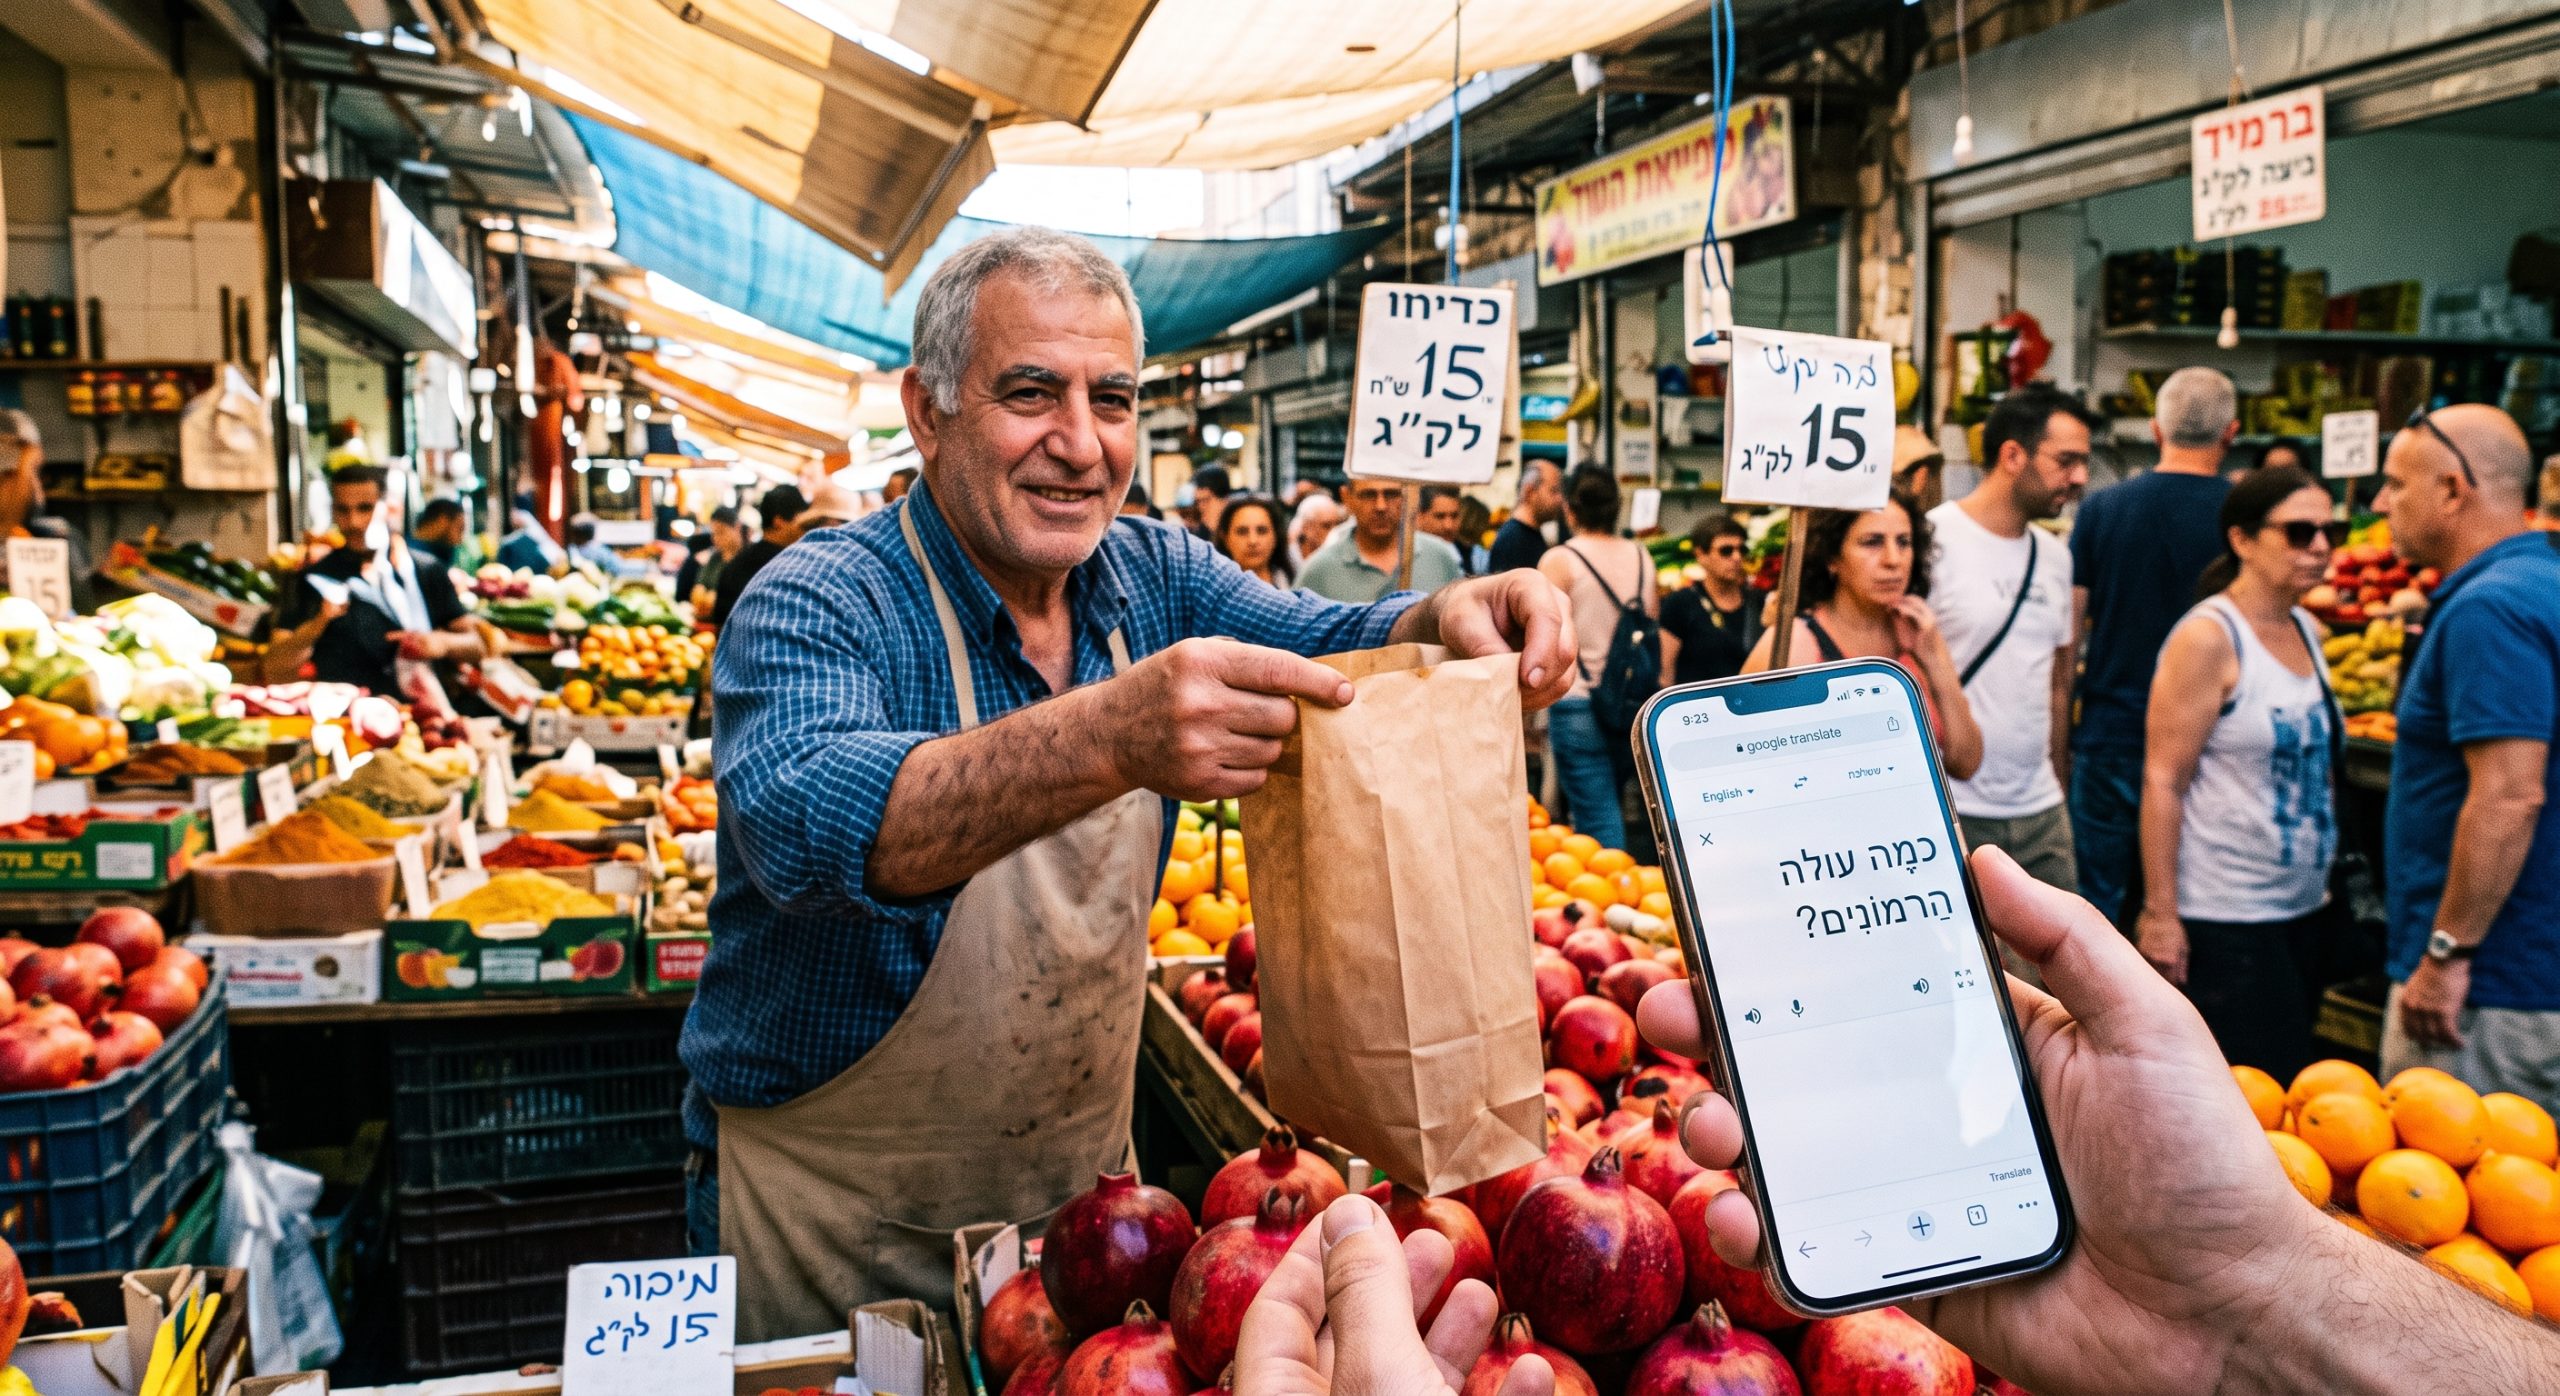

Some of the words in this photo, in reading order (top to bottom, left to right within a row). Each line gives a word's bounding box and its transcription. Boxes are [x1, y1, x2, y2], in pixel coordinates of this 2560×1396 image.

[2201, 103, 2315, 160] ברמיד
[1416, 341, 1486, 401] 15
[1372, 412, 1482, 459] לק"ג
[1800, 403, 1867, 472] 15
[1740, 444, 1793, 479] לק"ג
[1682, 712, 1710, 726] 9:23
[1746, 735, 1788, 755] google
[1789, 727, 1842, 745] translate
[1702, 787, 1743, 804] English
[1779, 848, 1855, 886] עולה
[1989, 1167, 2032, 1182] Translate
